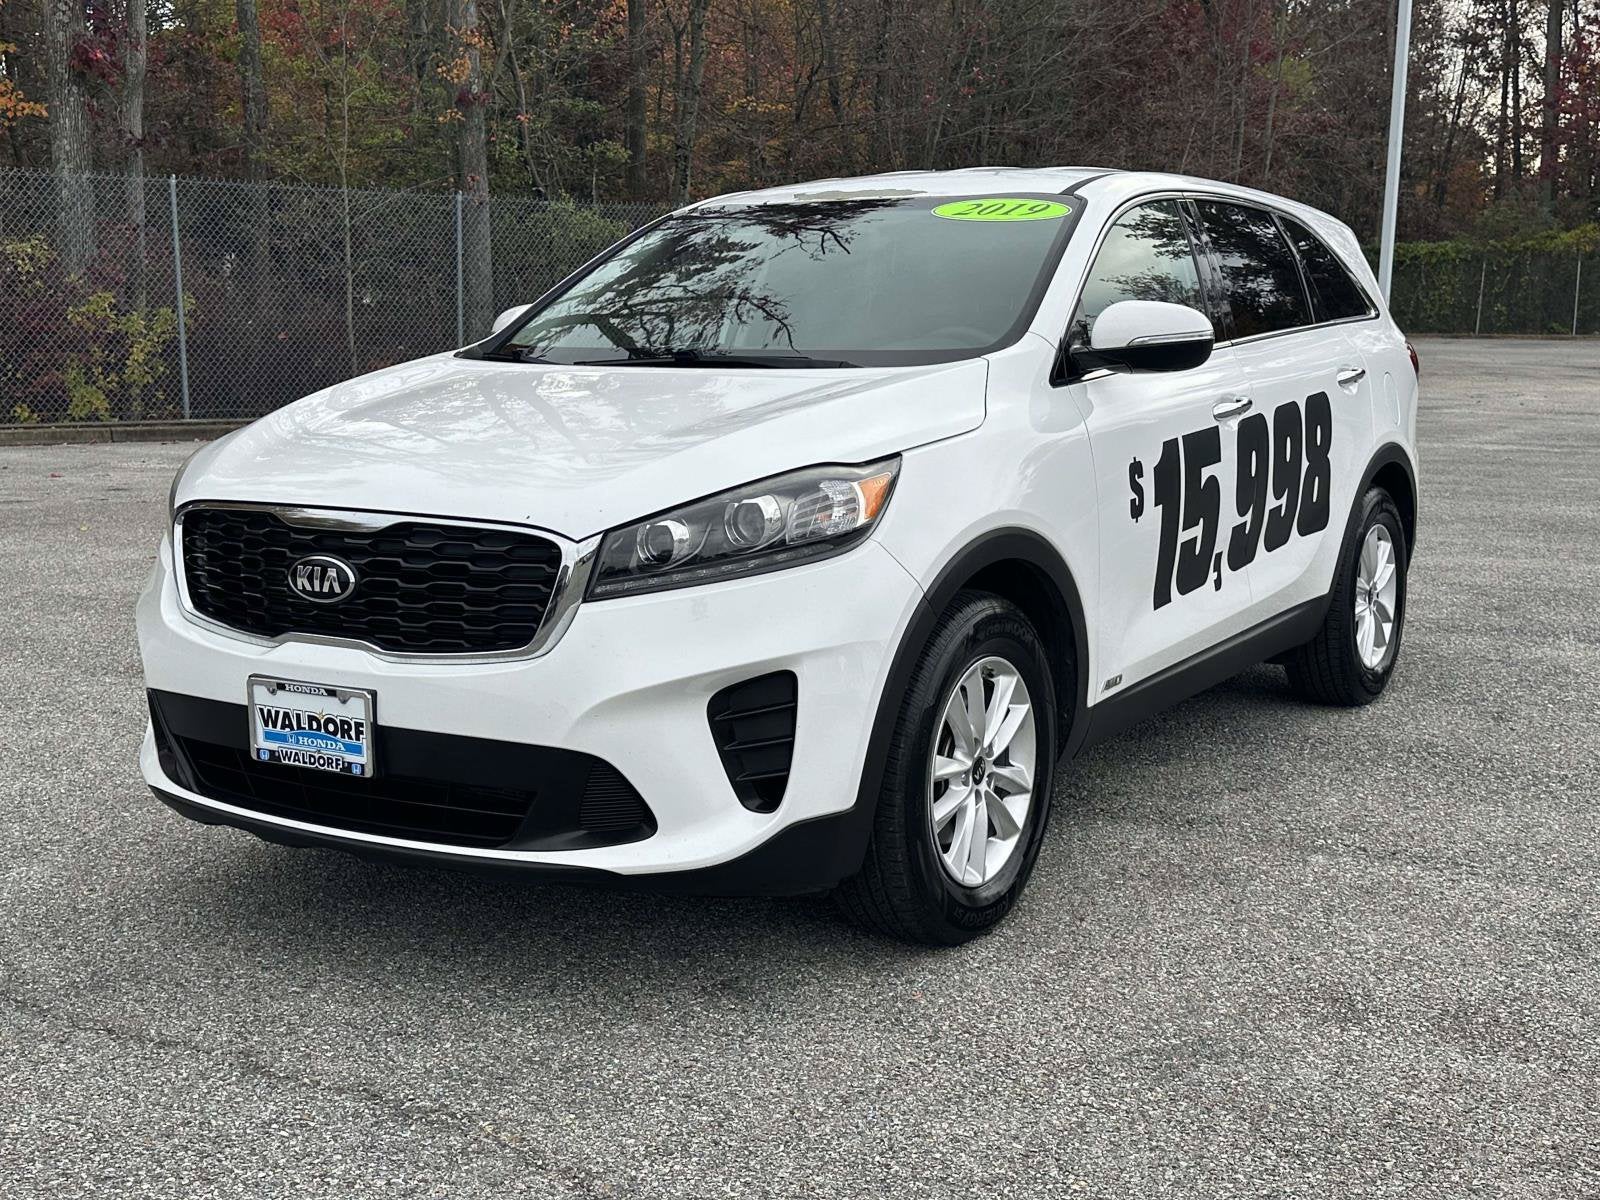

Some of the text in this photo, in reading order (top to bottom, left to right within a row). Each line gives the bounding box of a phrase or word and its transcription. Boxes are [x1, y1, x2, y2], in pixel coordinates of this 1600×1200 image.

[952, 202, 1051, 216] 2019
[296, 565, 342, 594] KIA
[285, 684, 328, 697] HONDA
[257, 706, 365, 742] WALDORF
[298, 736, 346, 751] HONDA
[279, 749, 342, 770] WALDORF
